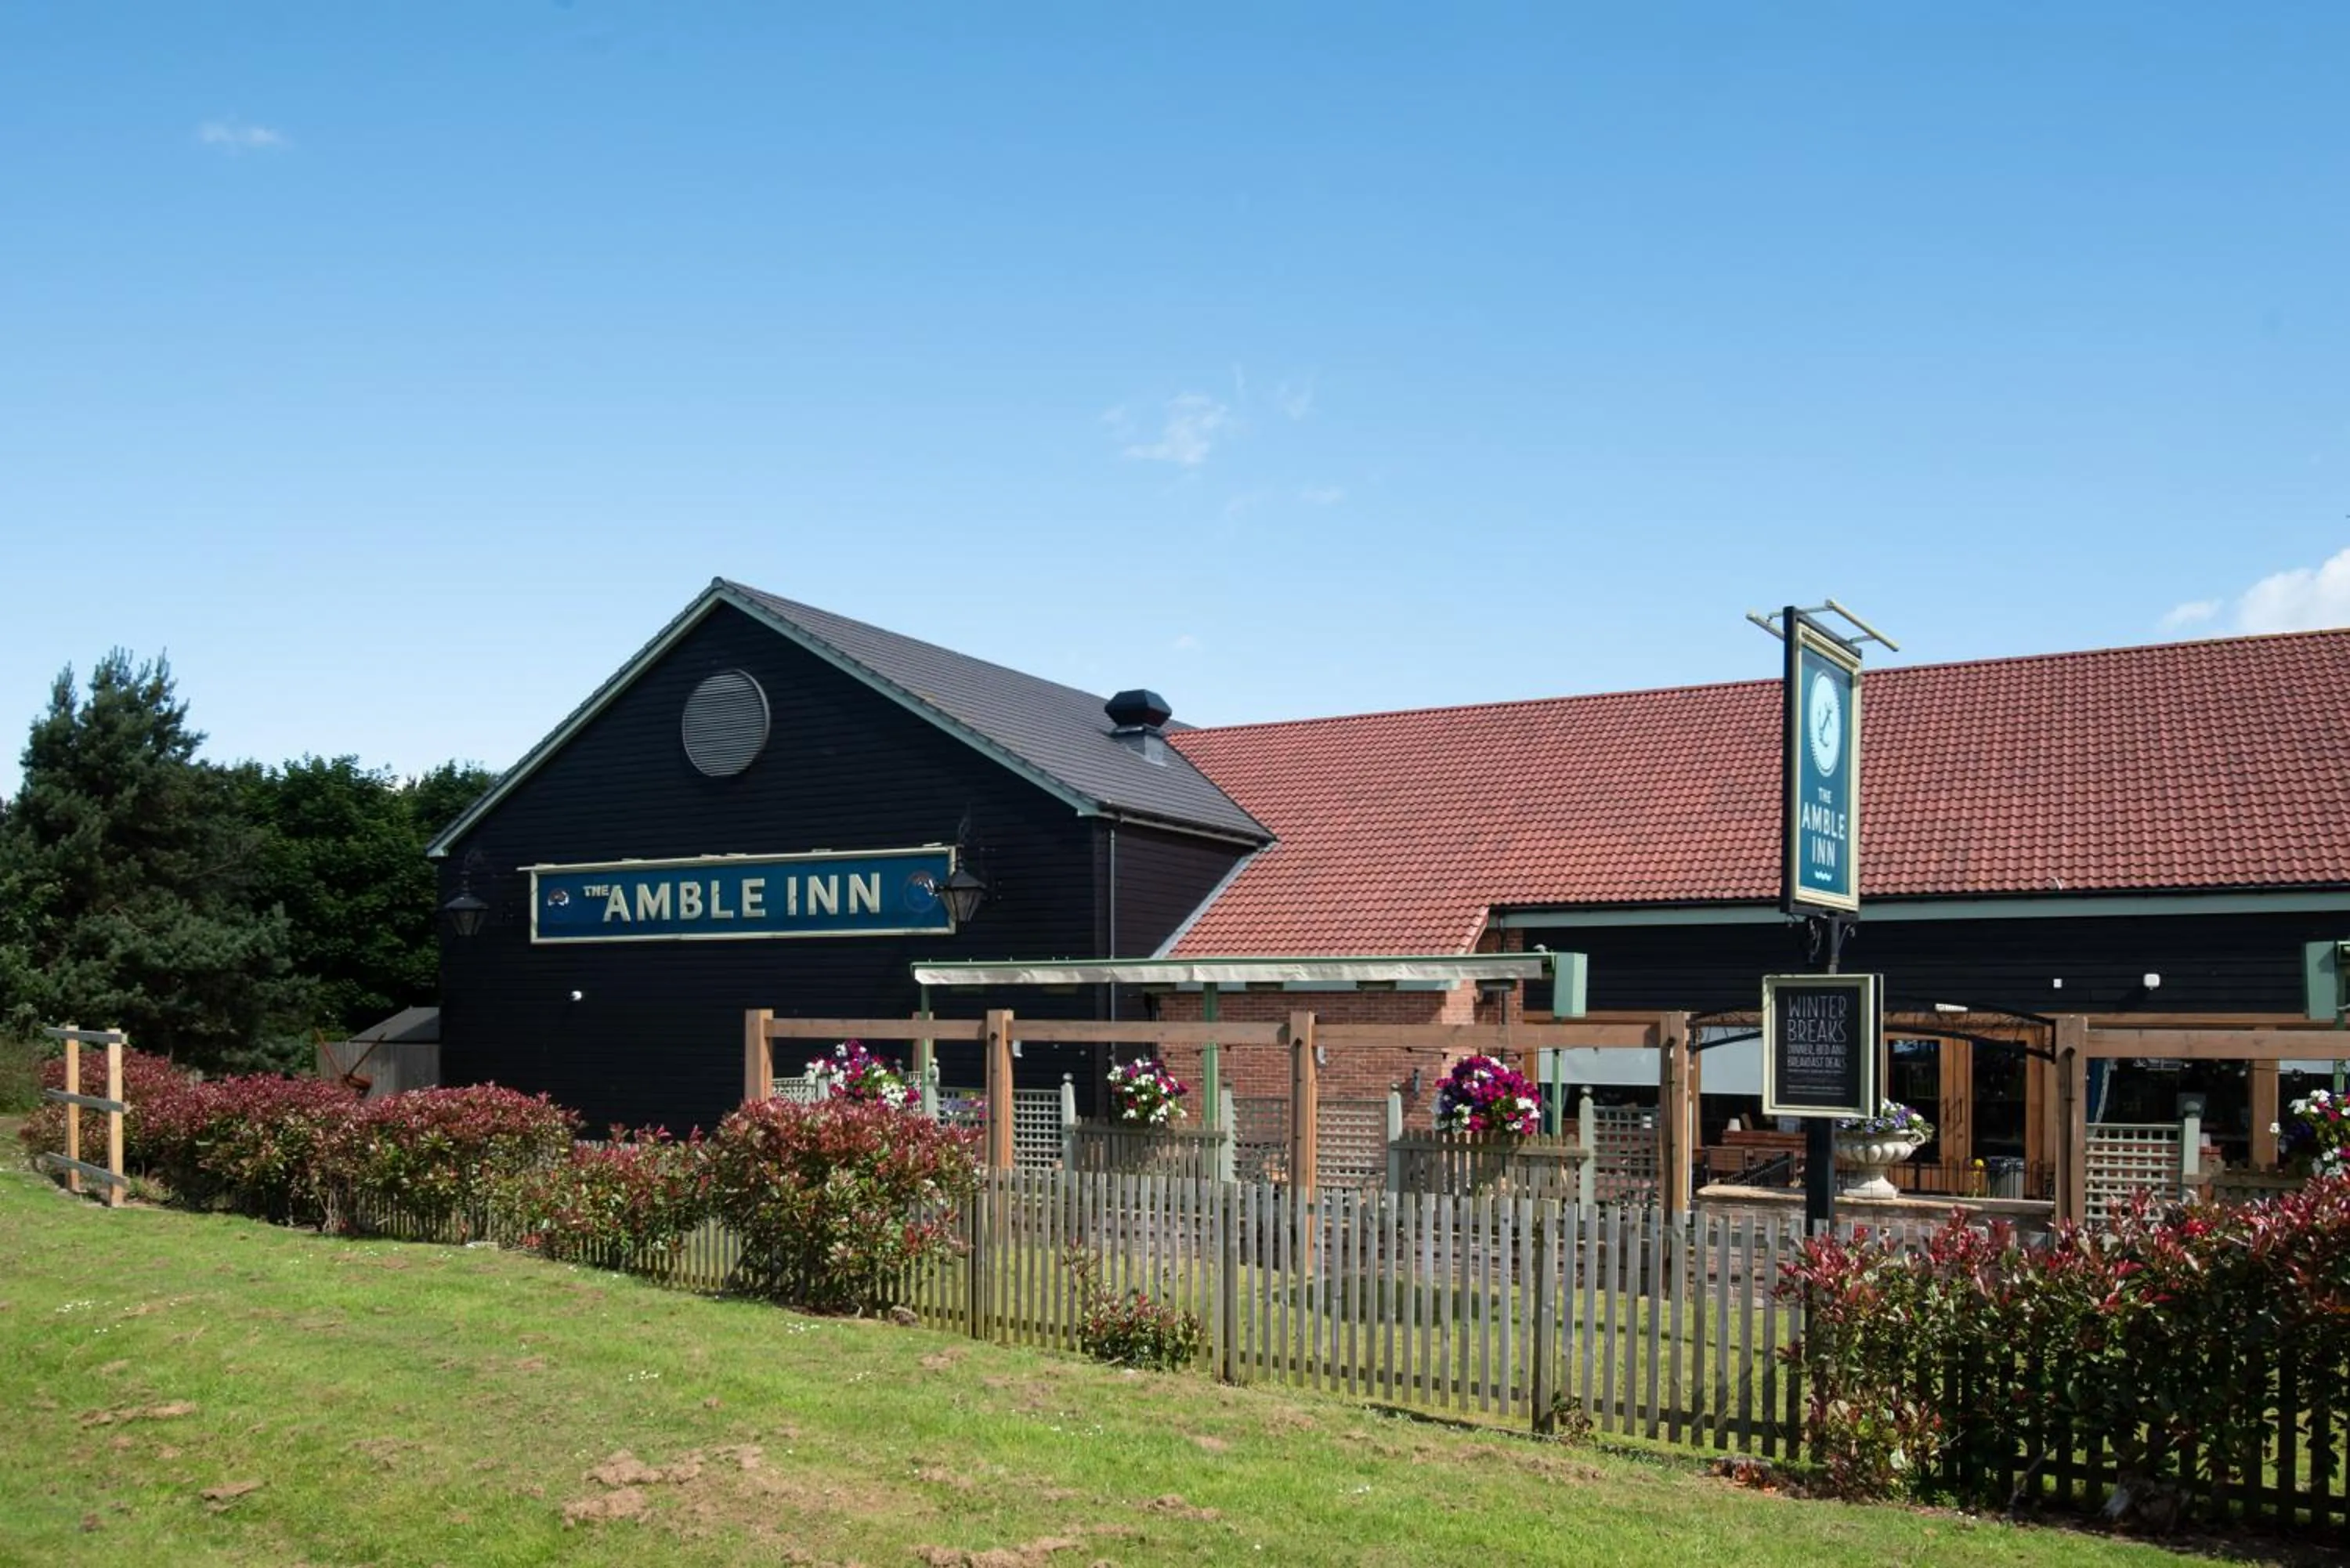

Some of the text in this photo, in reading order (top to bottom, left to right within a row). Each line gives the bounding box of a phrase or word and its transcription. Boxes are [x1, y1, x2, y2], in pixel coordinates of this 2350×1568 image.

[1817, 787, 1831, 804] THE
[1802, 801, 1845, 840] AMBLE
[1812, 836, 1835, 866] INN
[584, 872, 880, 922] THE AMBLE INN
[1788, 995, 1847, 1018] WINTER
[1787, 1020, 1847, 1042] BREAKS
